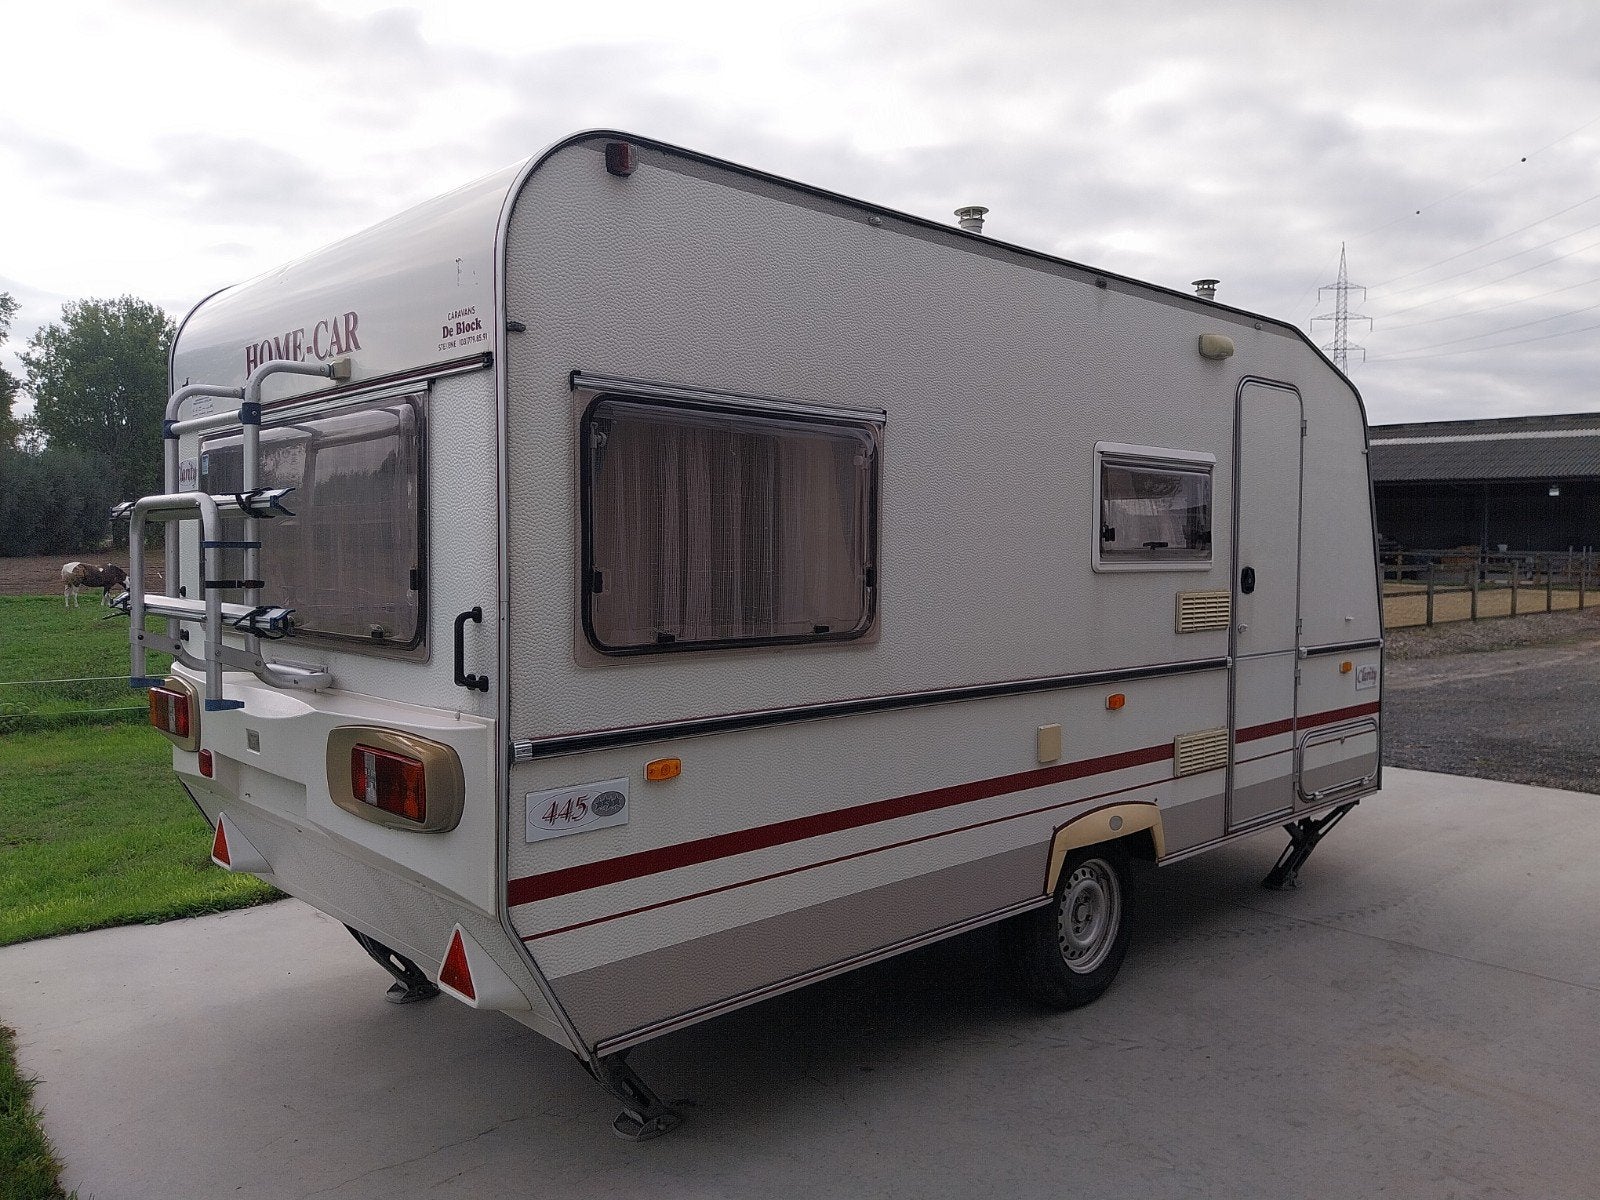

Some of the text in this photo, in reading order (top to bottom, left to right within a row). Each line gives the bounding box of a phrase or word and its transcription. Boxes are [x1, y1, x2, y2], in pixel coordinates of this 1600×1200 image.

[447, 305, 476, 321] CARAVANS
[442, 317, 483, 339] De Block
[245, 311, 362, 380] HOME-CAR
[541, 794, 591, 826] 445
